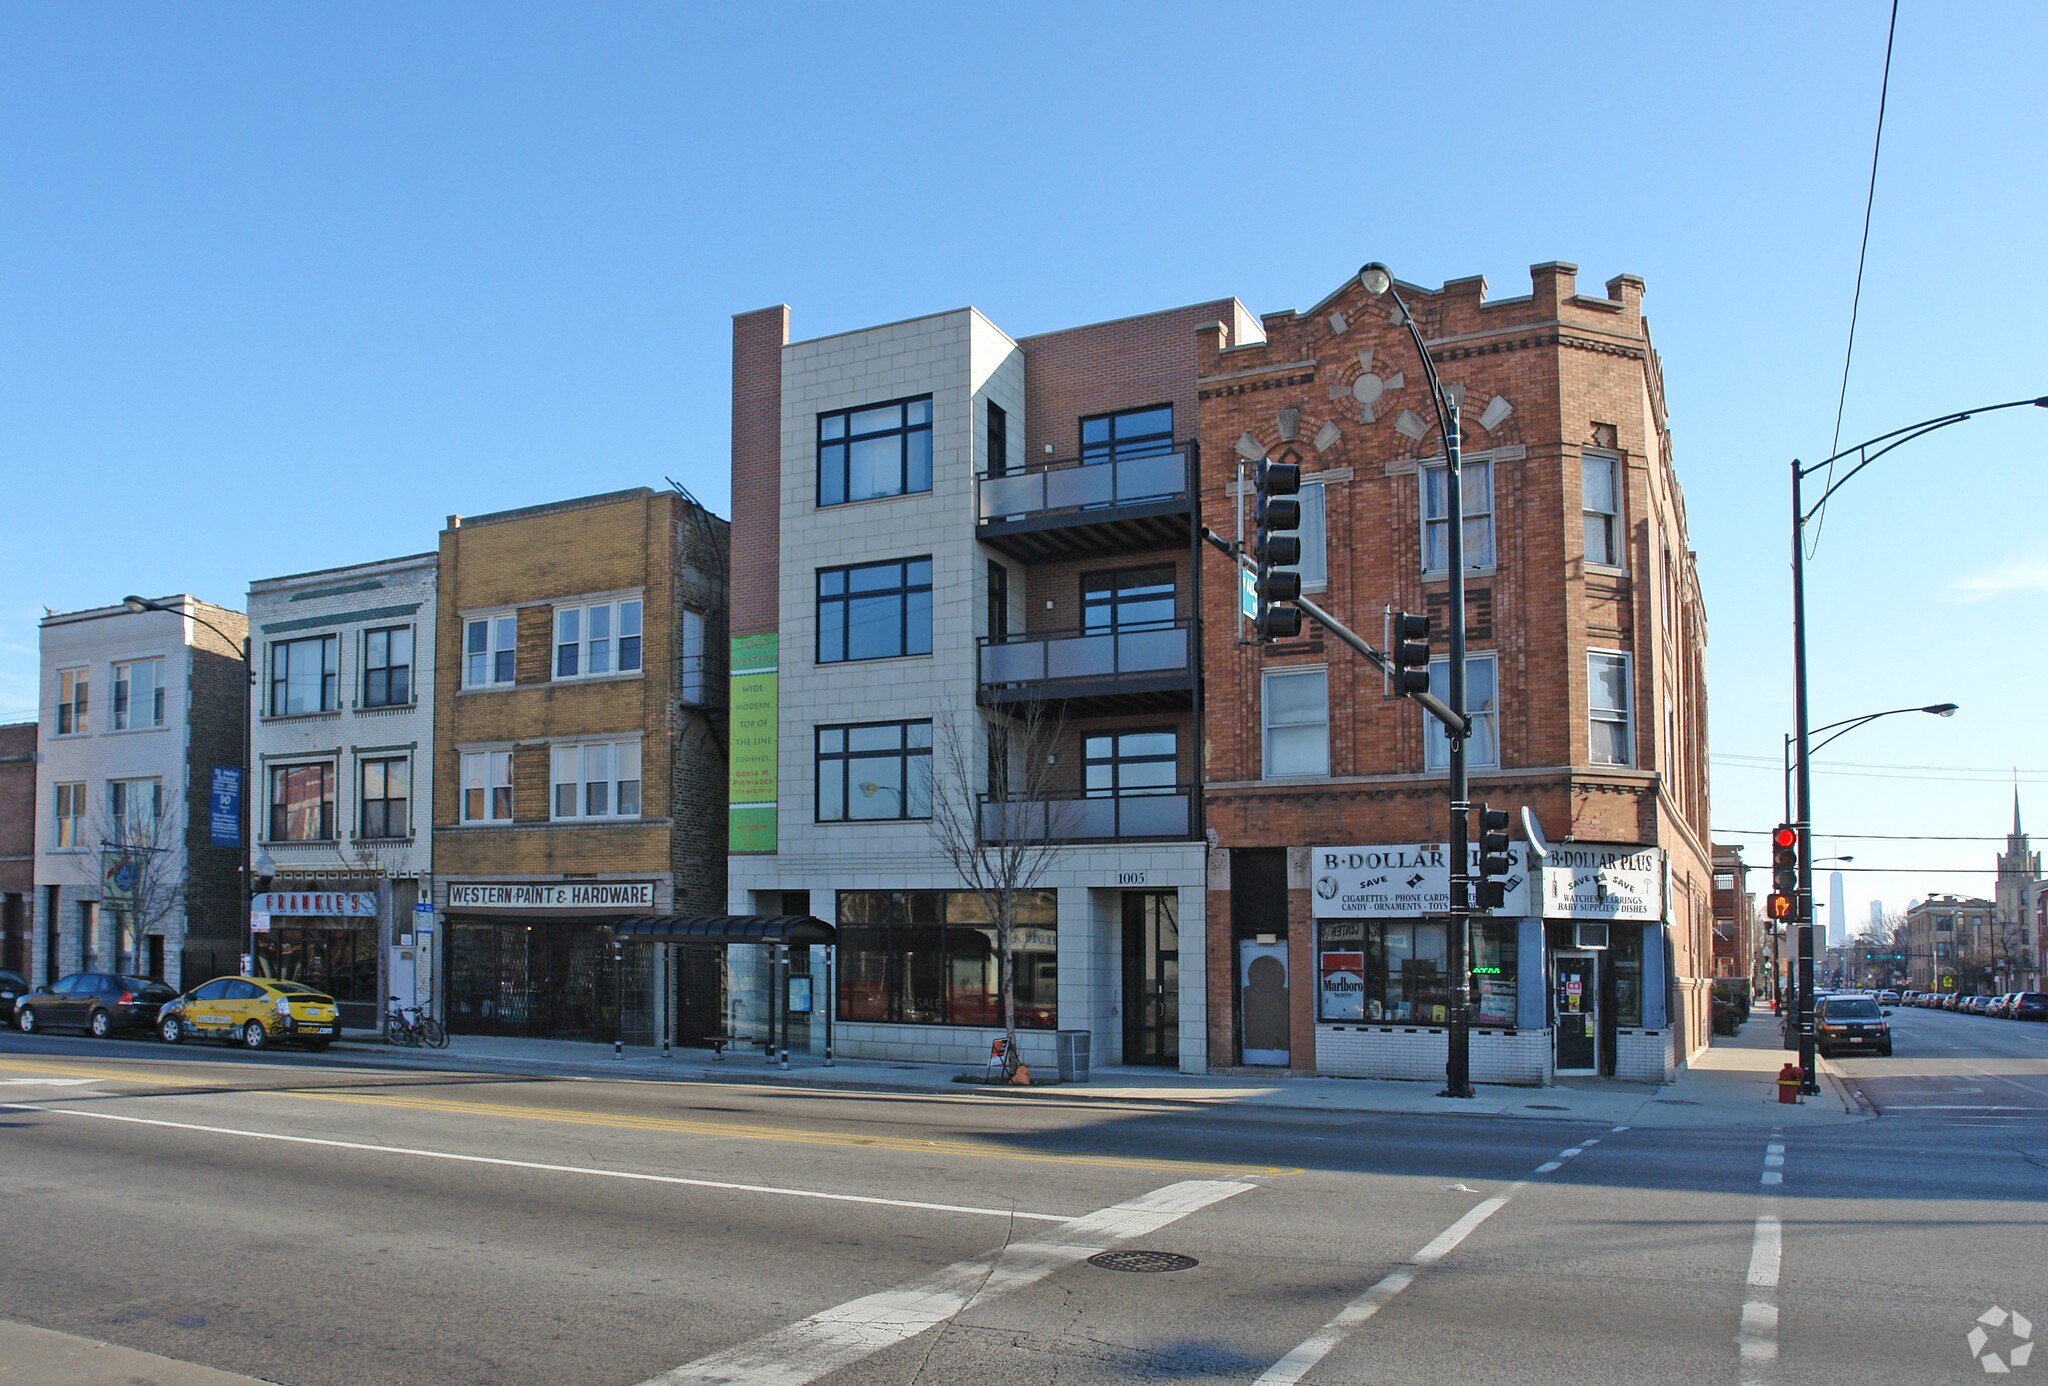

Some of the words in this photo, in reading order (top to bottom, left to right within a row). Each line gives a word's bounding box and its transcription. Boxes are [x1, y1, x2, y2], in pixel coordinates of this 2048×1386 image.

[740, 720, 755, 729] TOP
[757, 719, 768, 728] OF
[735, 738, 751, 746] THE
[754, 736, 772, 745] LINE
[219, 795, 231, 805] 90
[1621, 853, 1652, 871] PLUS
[1118, 872, 1145, 885] 1005
[1359, 875, 1388, 889] SAVE
[1568, 875, 1591, 890] SAVE
[1612, 876, 1635, 893] SAVE
[452, 886, 512, 903] WESTERN
[516, 886, 555, 904] PAINT
[556, 890, 568, 904] &
[1341, 894, 1388, 903] CIGARETTES
[1395, 894, 1421, 902] PHONE
[1424, 893, 1450, 901] CARDS
[1563, 894, 1599, 904] WATCHES
[1604, 895, 1643, 905] EARRINGS
[266, 894, 359, 912] FRANKIE'S
[1341, 902, 1368, 911] CANDY
[1374, 902, 1422, 911] ORNAMENTS
[1429, 902, 1449, 910] TOYS
[1558, 903, 1577, 911] BABY
[1579, 903, 1615, 912] SUPPLIES
[1621, 905, 1648, 914] DISHES
[1323, 977, 1363, 992] Marlboro
[894, 997, 915, 1009] FOR
[917, 998, 942, 1009] SALE
[196, 1015, 232, 1024] costar.com
[297, 1025, 333, 1035] costar.com
